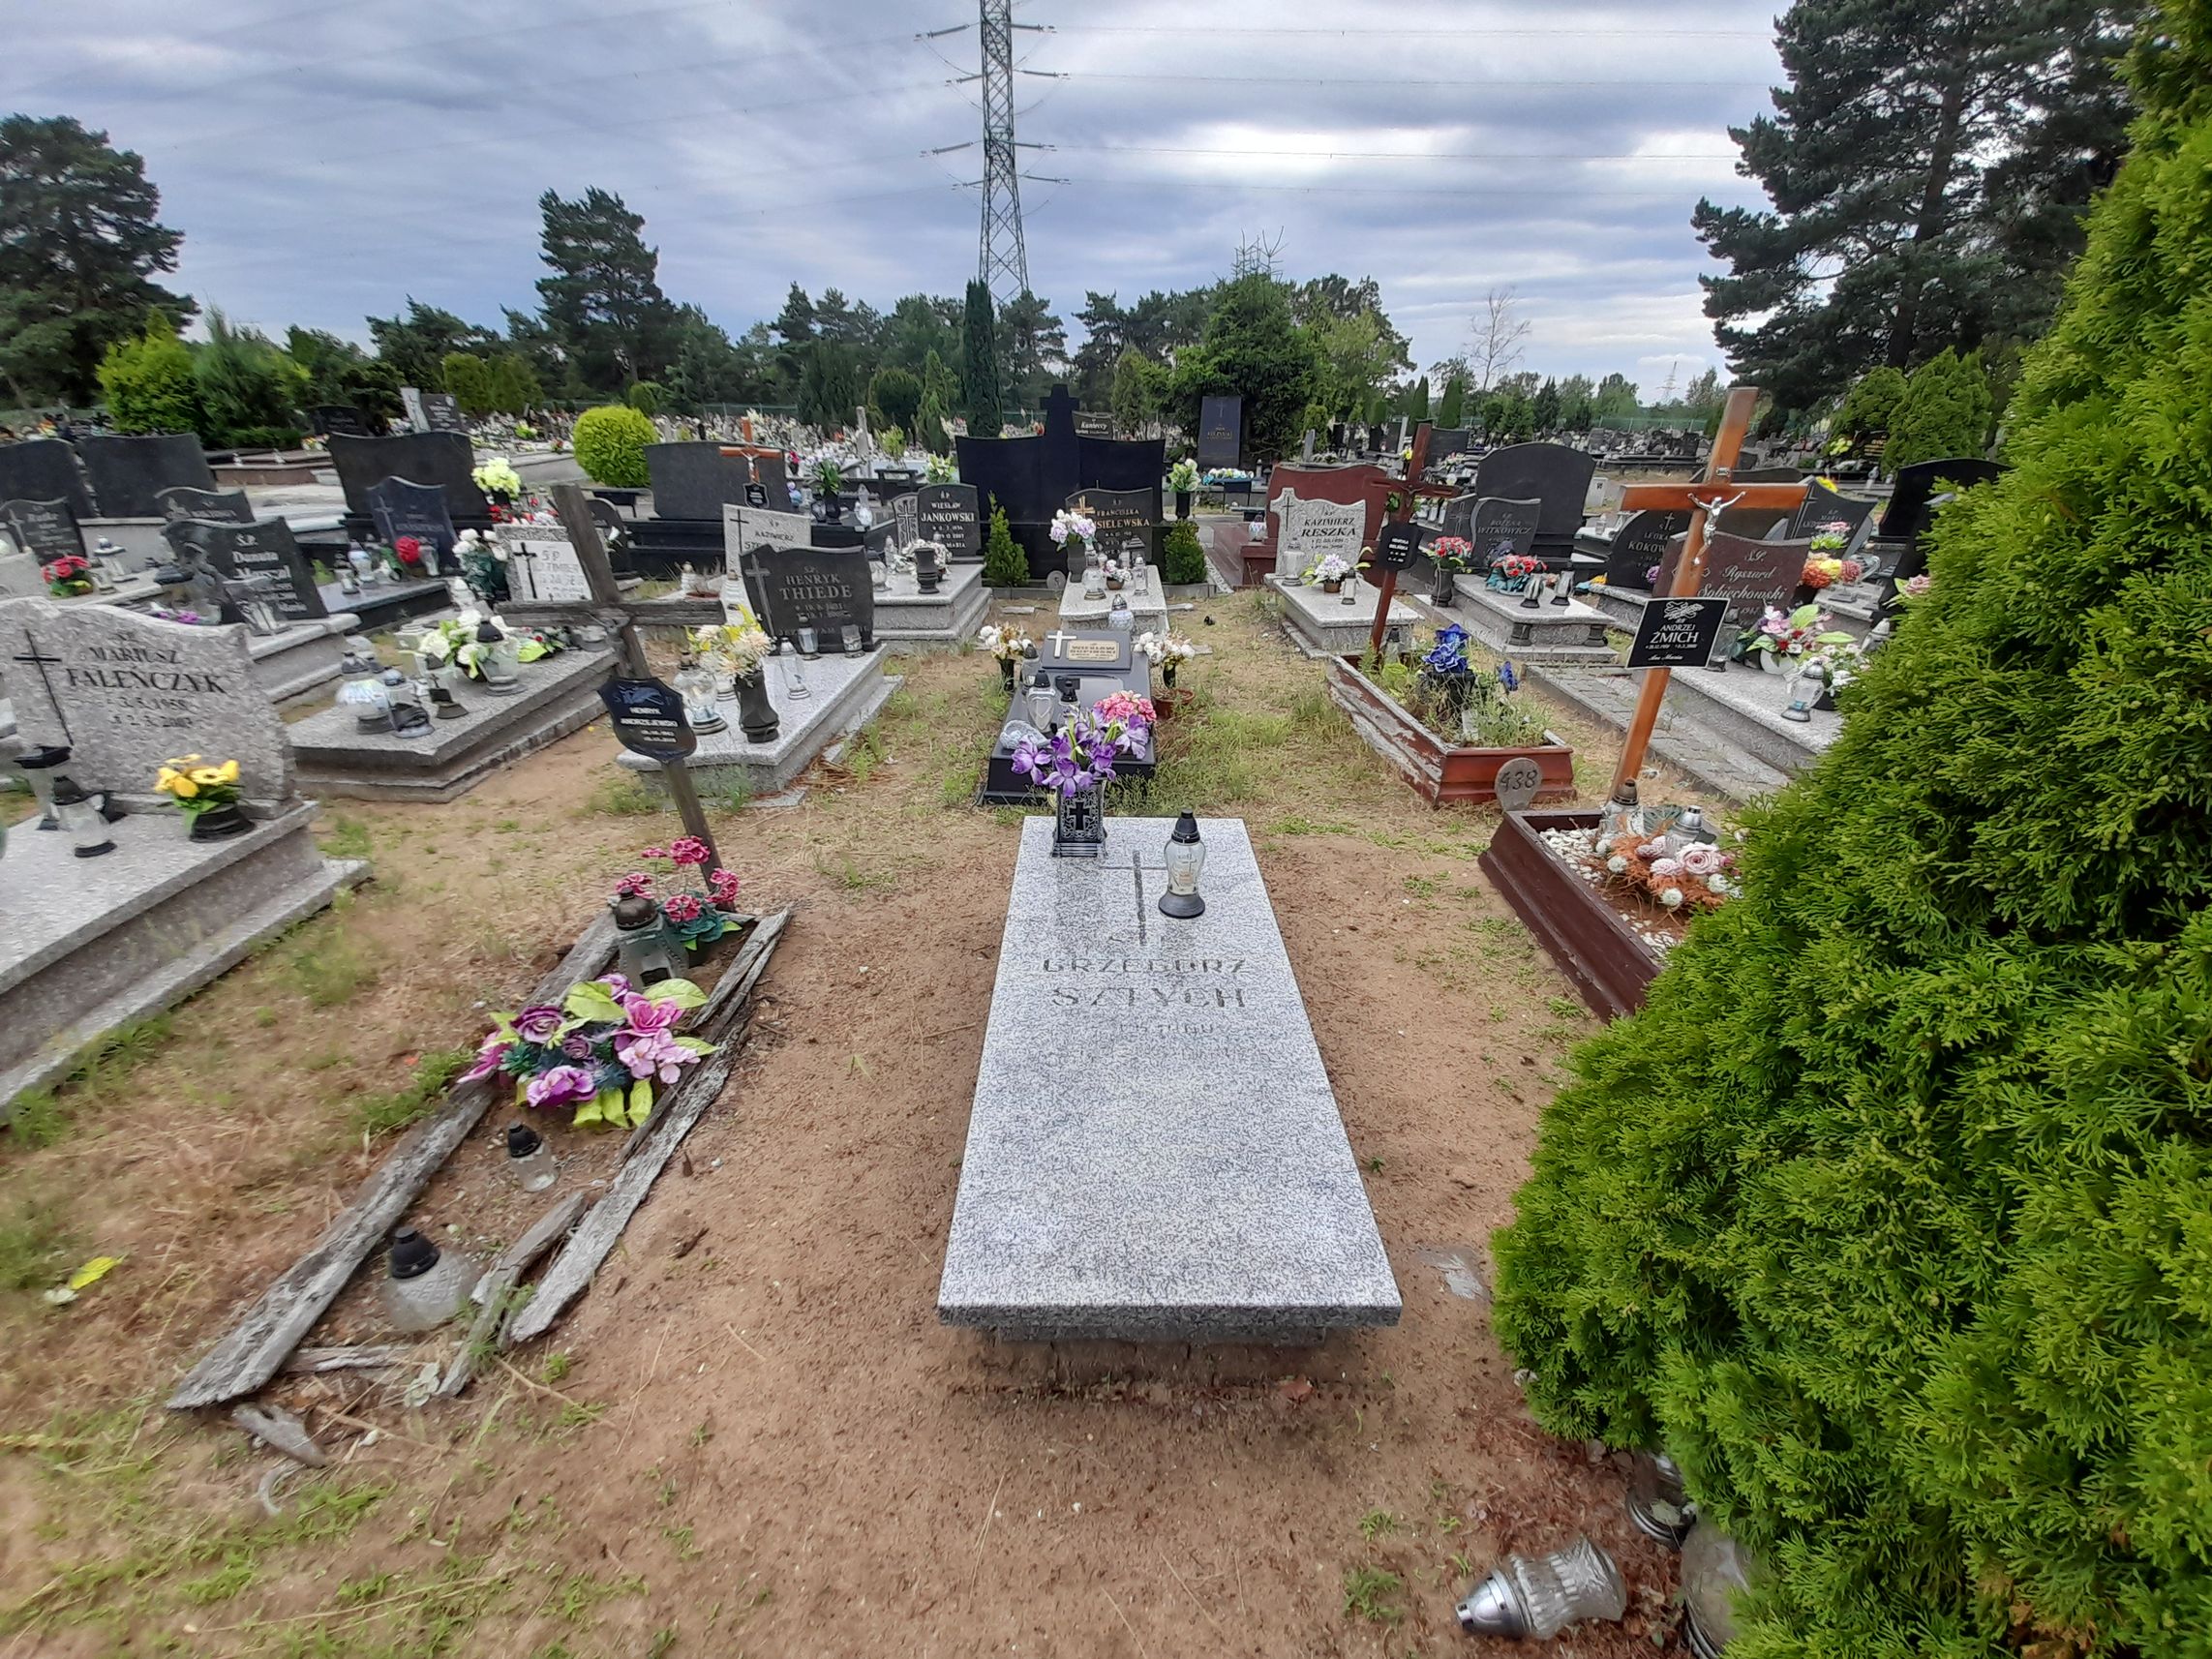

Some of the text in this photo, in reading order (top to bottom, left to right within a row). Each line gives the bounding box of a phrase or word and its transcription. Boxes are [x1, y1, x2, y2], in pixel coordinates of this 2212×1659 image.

[921, 513, 975, 523] JANKOWSKI
[1304, 517, 1355, 527] KAZIMIERZ
[1301, 528, 1356, 537] RESZKA
[1644, 531, 1668, 540] LEOKA
[1627, 540, 1665, 553] KOKOW
[785, 574, 841, 586] HENRYK
[1722, 564, 1777, 583] Ryszard
[779, 585, 853, 600] THIEDE
[1697, 583, 1788, 600] Sobiechowski
[1660, 623, 1696, 632] ANDRZEJ
[89, 647, 182, 665] MARIUSZ
[66, 666, 228, 694] FALEŃCZYK
[1500, 769, 1537, 793] 438
[1044, 958, 1246, 973] GRZEGORZ
[1051, 987, 1246, 1008] SZTYCH
